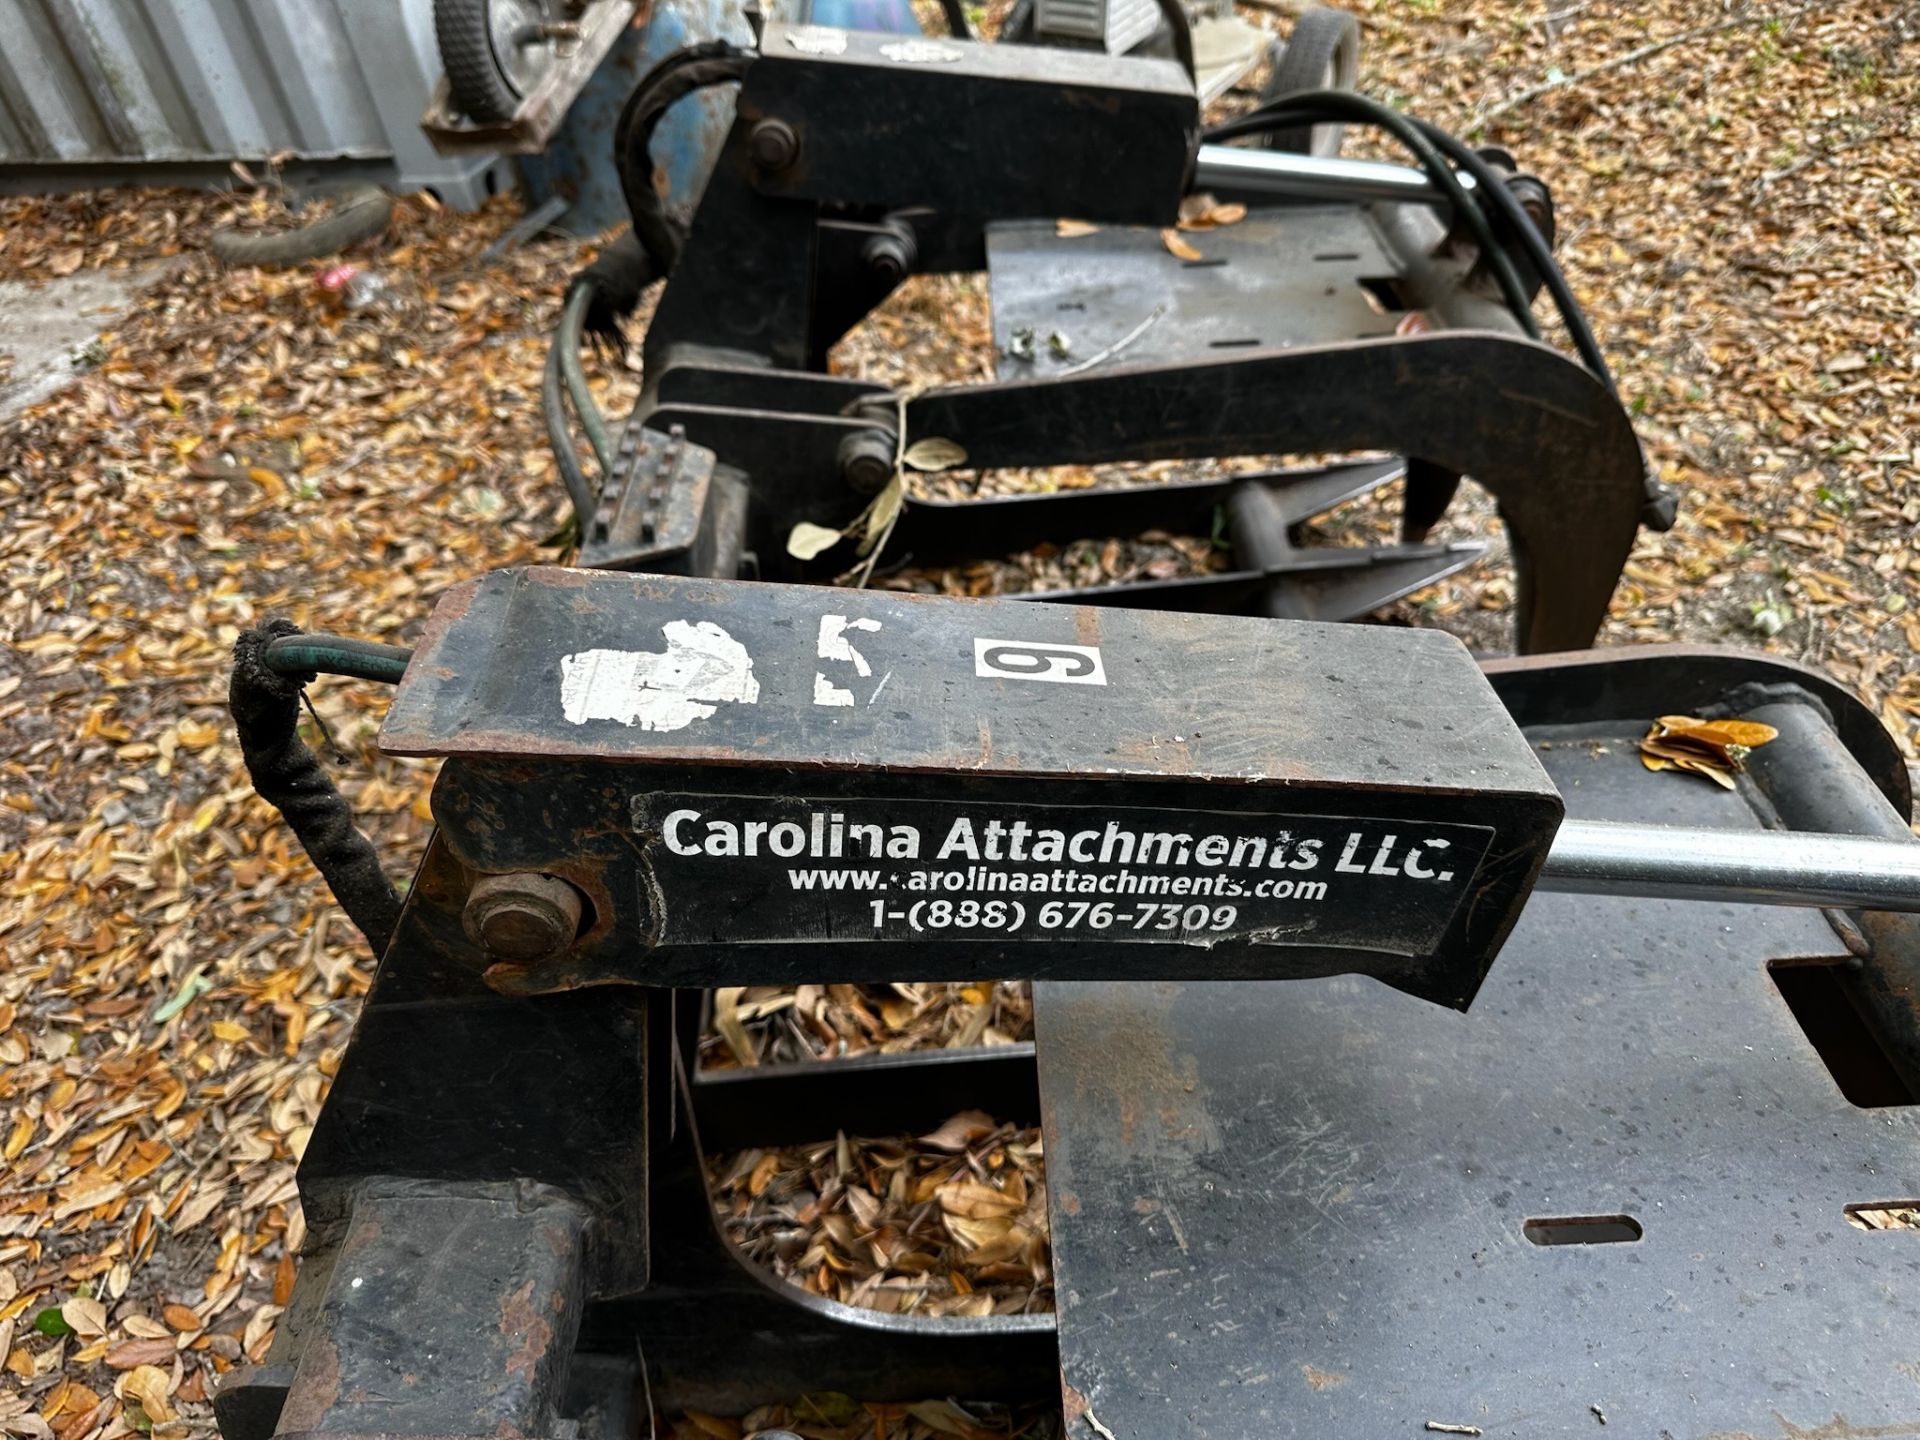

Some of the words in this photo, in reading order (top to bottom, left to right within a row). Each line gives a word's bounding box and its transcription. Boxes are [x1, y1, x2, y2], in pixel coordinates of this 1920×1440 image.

[662, 809, 920, 859] Carolina
[936, 817, 1325, 871] Attachments
[1334, 832, 1455, 882] LLC.
[787, 866, 1329, 901] www.arolinaattachments.com
[869, 899, 1026, 933] 1-(888)
[1038, 901, 1238, 932] 676-7309
